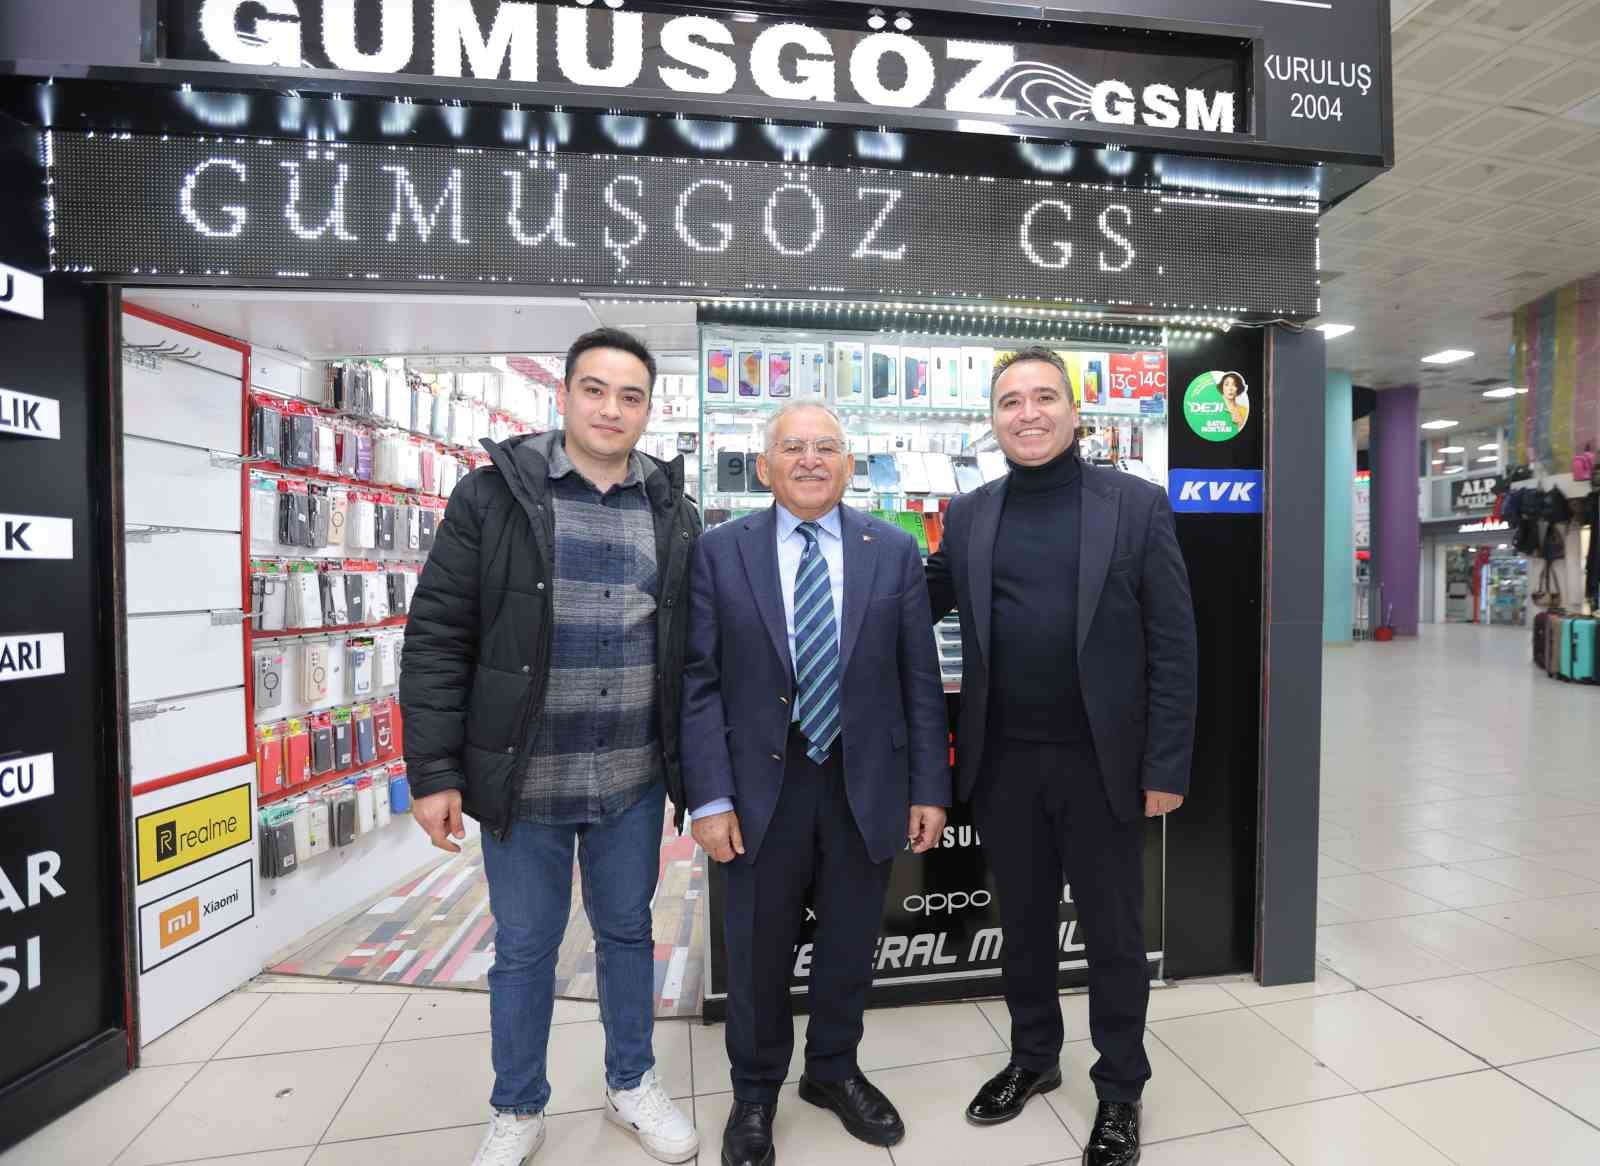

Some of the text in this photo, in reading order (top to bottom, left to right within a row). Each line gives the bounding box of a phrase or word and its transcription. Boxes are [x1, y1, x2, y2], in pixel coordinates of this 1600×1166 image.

[1264, 54, 1372, 96] KURULUŞ
[1089, 80, 1235, 134] GSM
[1290, 92, 1344, 122] 2004
[178, 148, 907, 272] GÜMÜŞGÖZ
[1110, 373, 1137, 390] 13C
[1139, 370, 1166, 388] 14C
[1179, 481, 1256, 501] KVK
[1461, 479, 1497, 496] ALP
[180, 816, 238, 852] realme
[203, 889, 240, 917] Xiaomi
[904, 889, 991, 916] oppo
